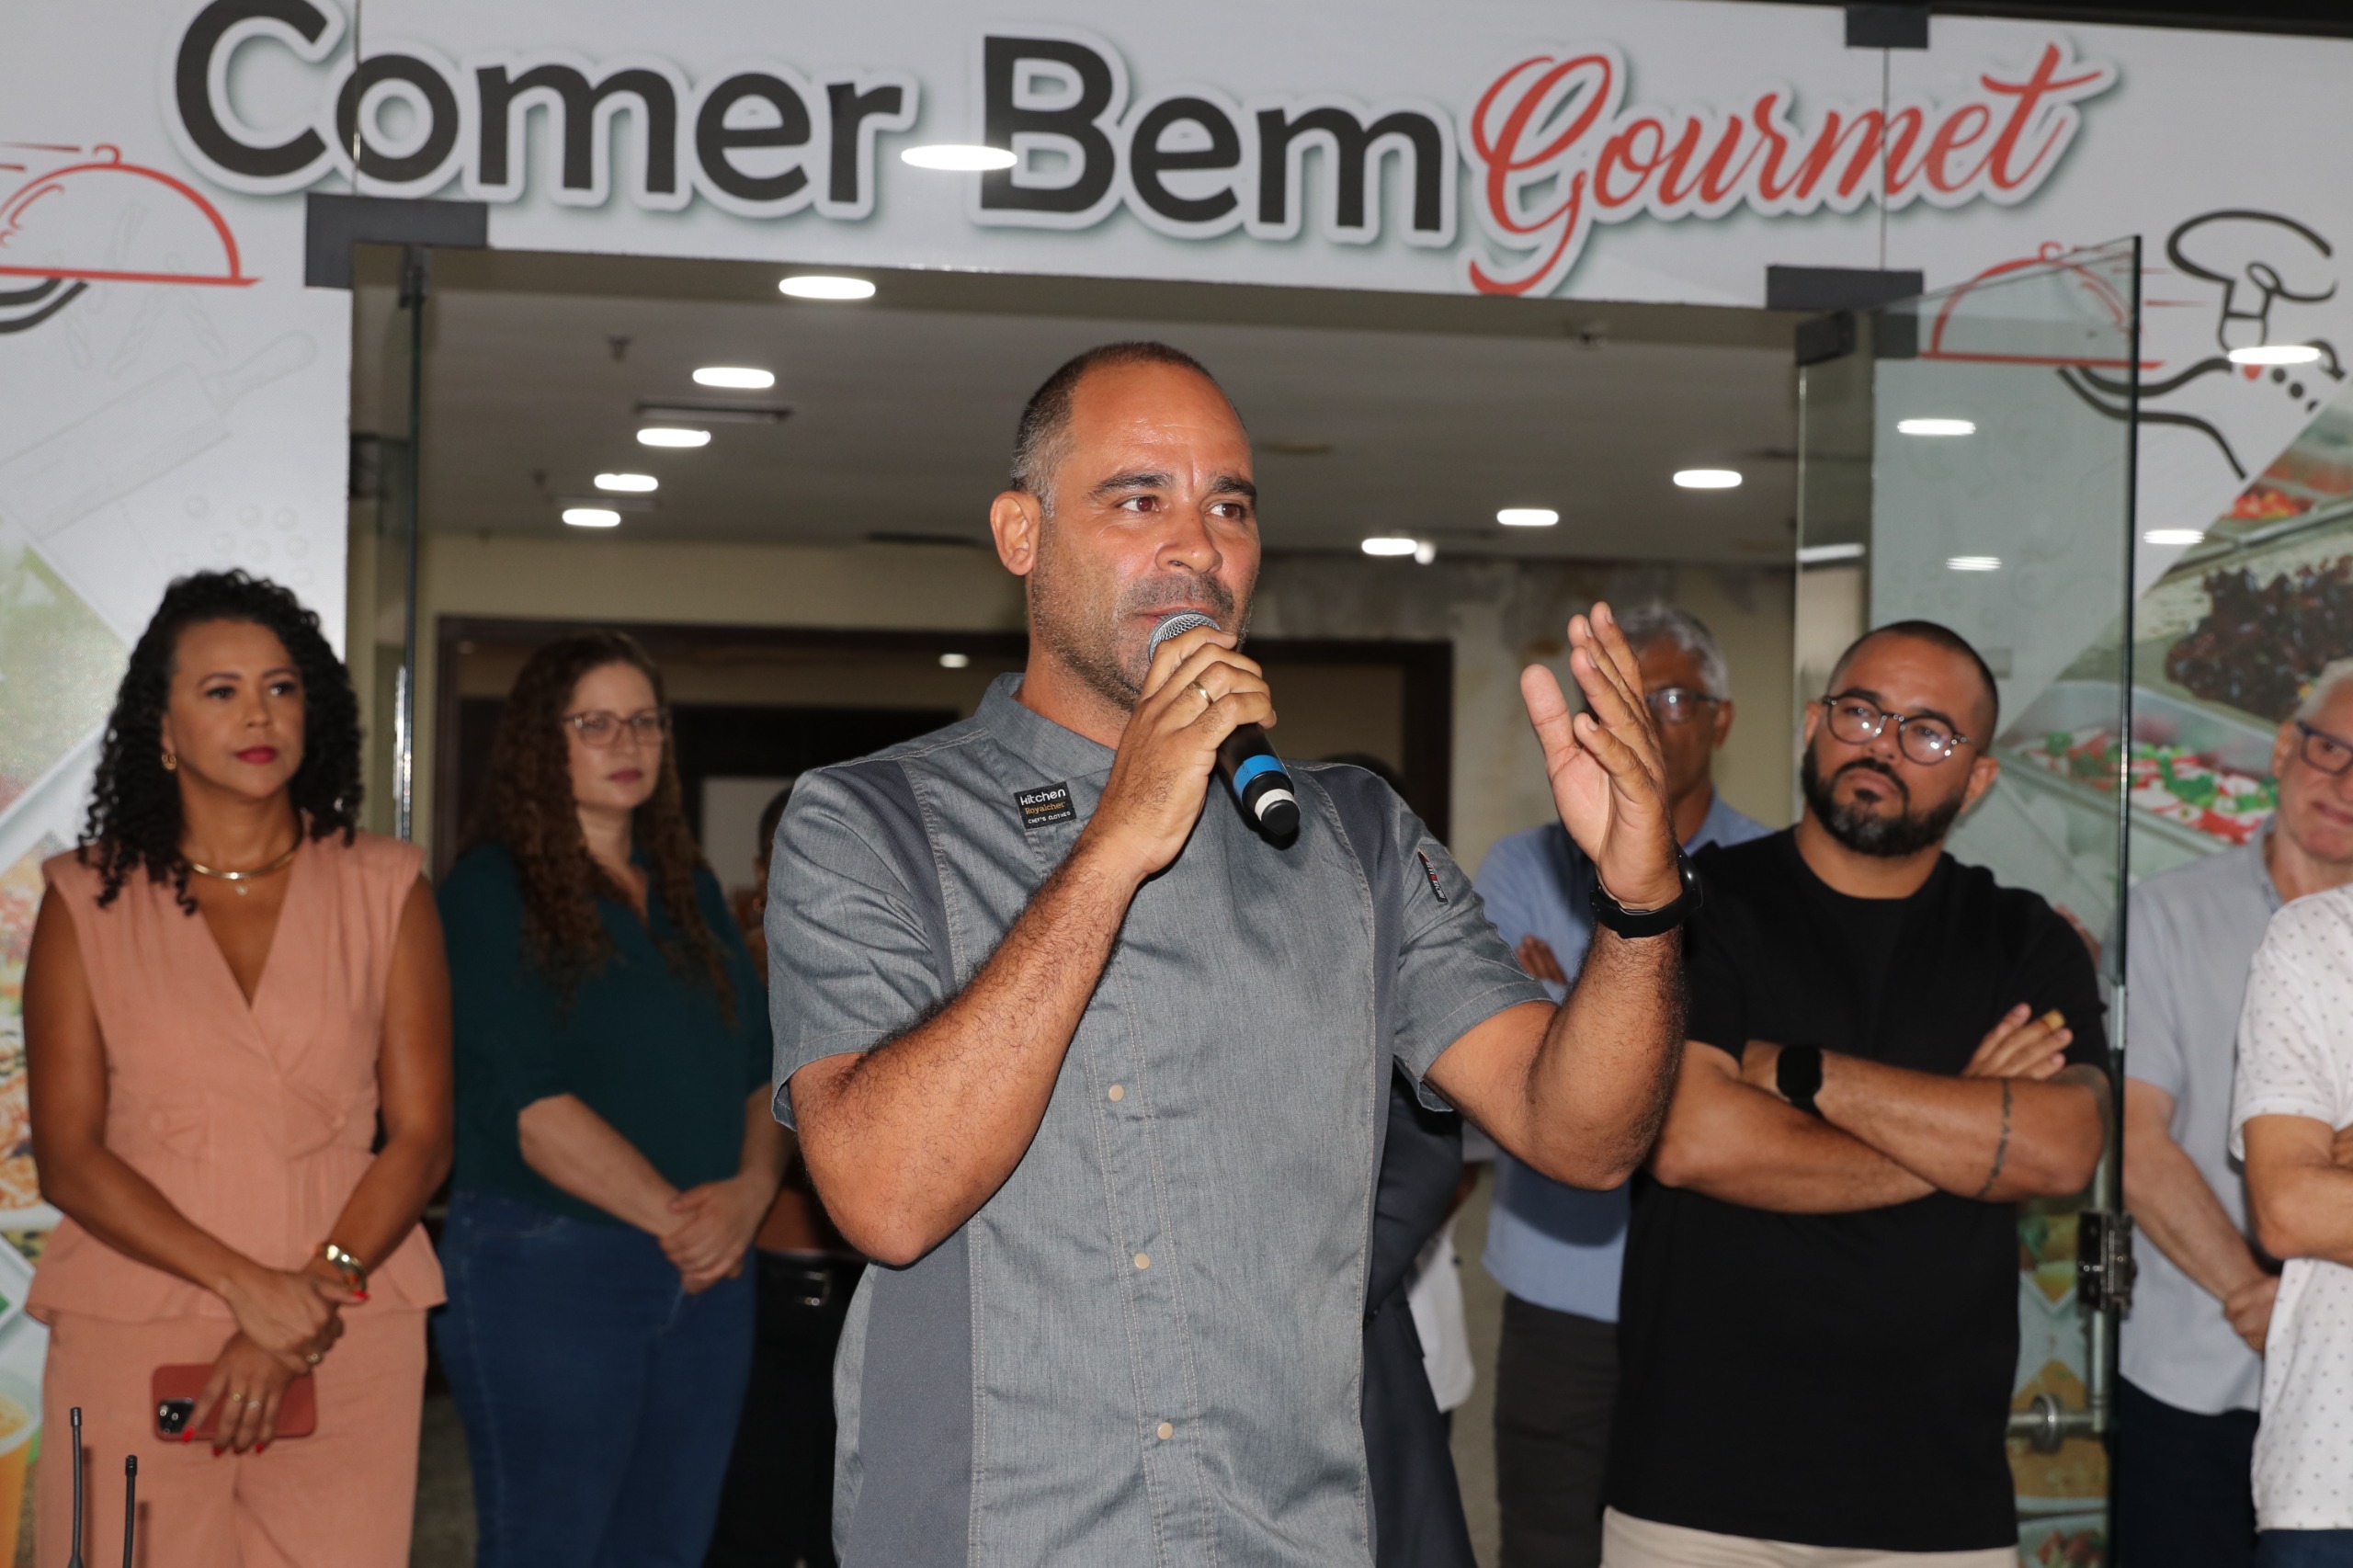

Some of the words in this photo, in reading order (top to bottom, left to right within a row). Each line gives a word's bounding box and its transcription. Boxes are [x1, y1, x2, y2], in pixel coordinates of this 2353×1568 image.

[175, 0, 903, 204] Comer
[981, 35, 1443, 233] Bem
[1469, 41, 2103, 299] Gourmet
[1019, 789, 1066, 806] kitchen
[1048, 811, 1072, 821] CLOTHES
